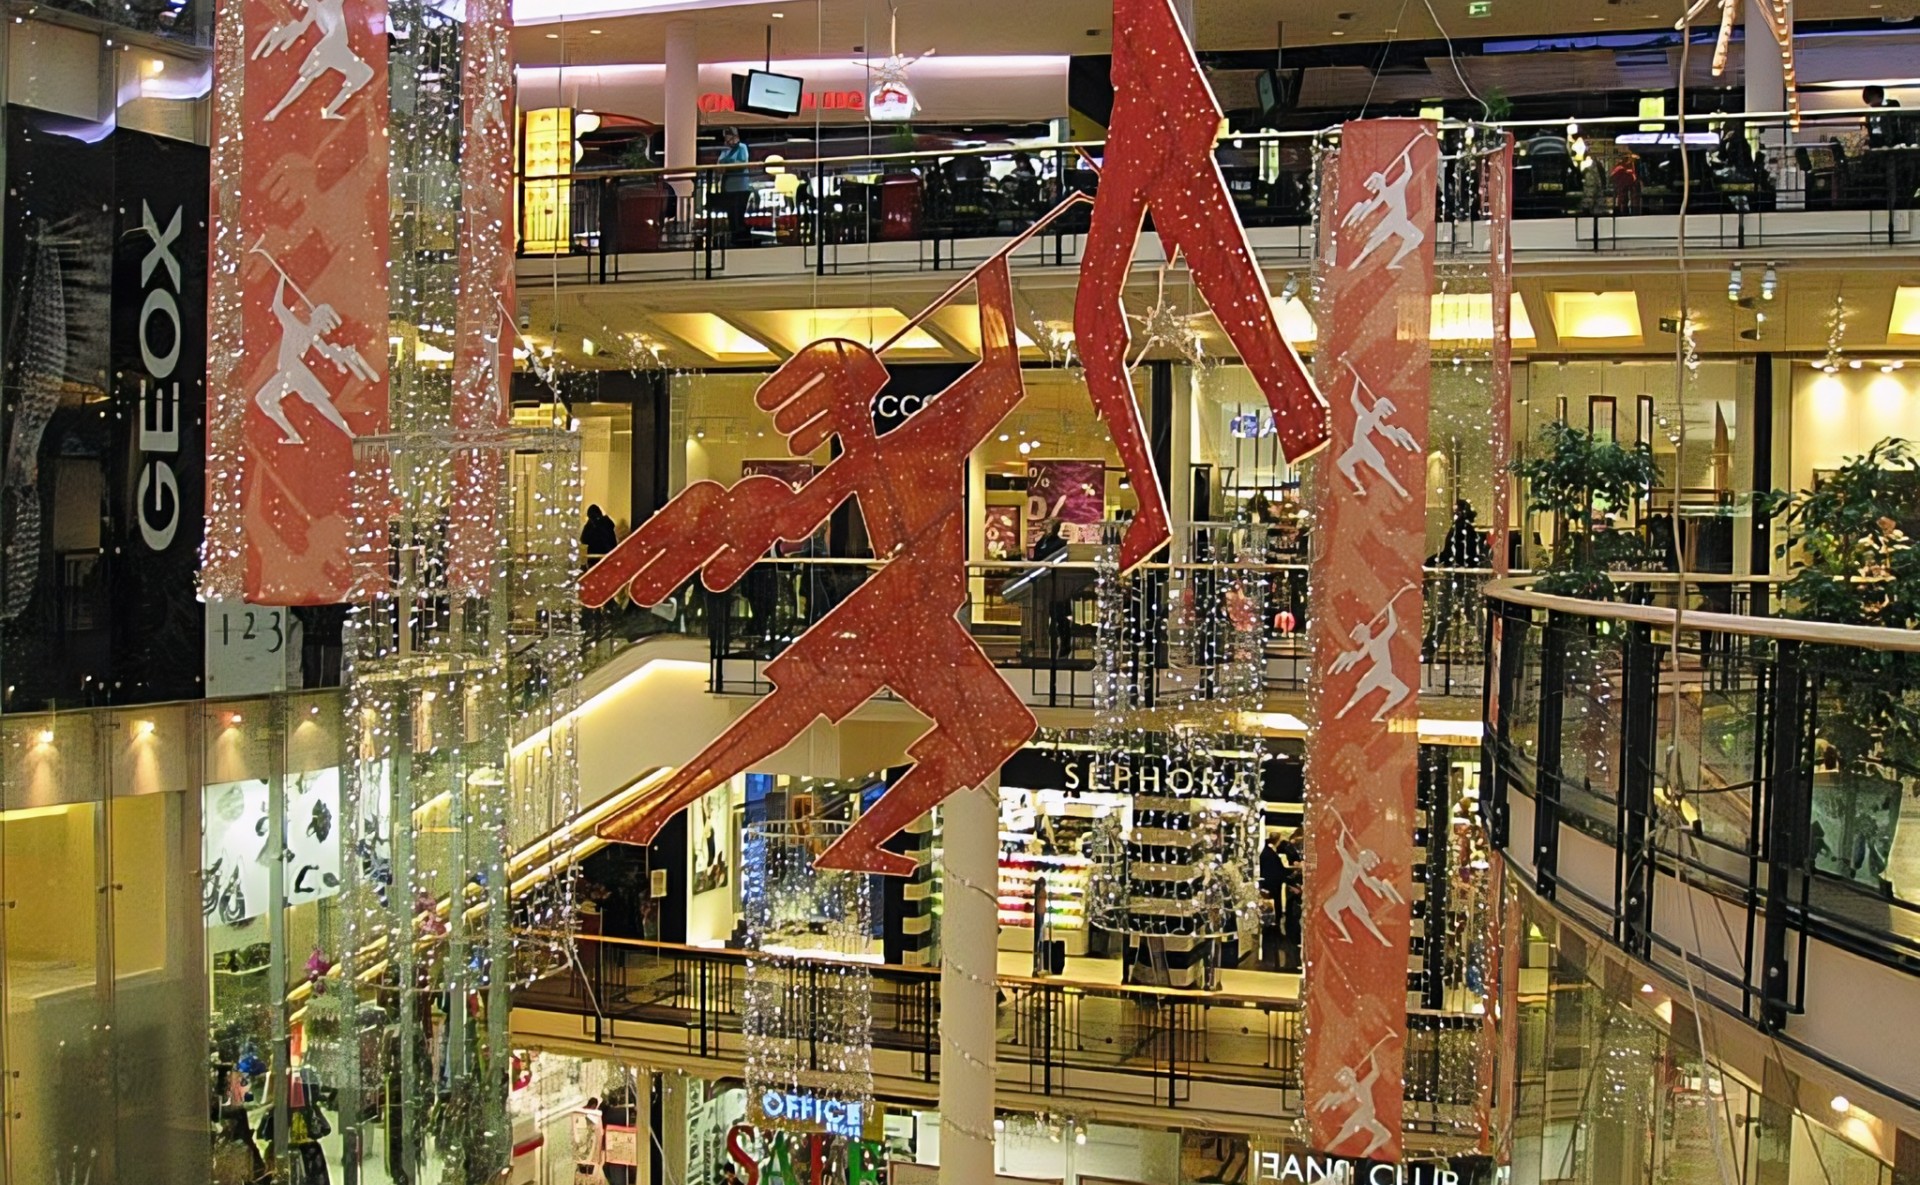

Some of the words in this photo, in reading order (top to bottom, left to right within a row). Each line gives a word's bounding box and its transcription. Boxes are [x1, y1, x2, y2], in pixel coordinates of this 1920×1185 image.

[137, 198, 183, 551] GEOX
[1064, 762, 1254, 797] SEPHORA
[762, 1091, 863, 1125] OFFICE
